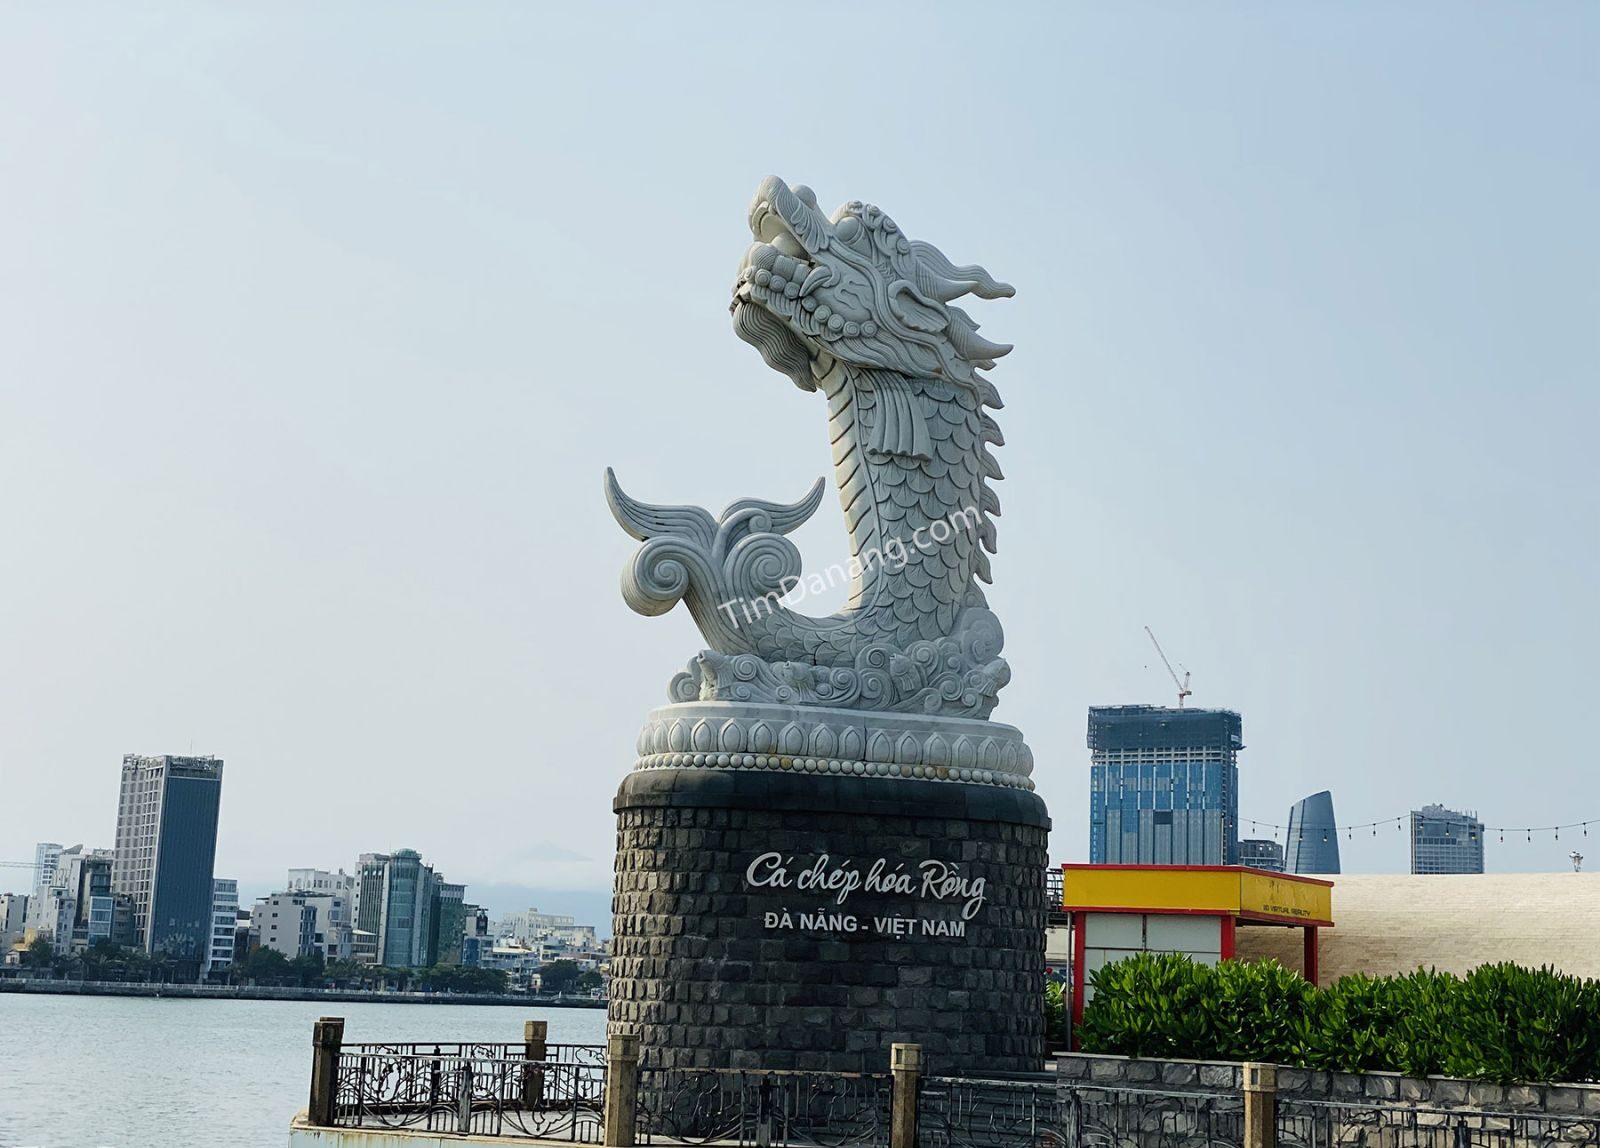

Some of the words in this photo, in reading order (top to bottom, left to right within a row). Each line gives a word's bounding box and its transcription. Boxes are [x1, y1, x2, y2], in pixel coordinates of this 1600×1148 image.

[746, 852, 793, 887] Cá
[797, 854, 861, 904] chép
[864, 857, 916, 894] hóa
[918, 859, 986, 920] Rồng
[764, 907, 793, 929] ĐÀ
[874, 913, 918, 940] VIỆT
[921, 919, 966, 937] NAM
